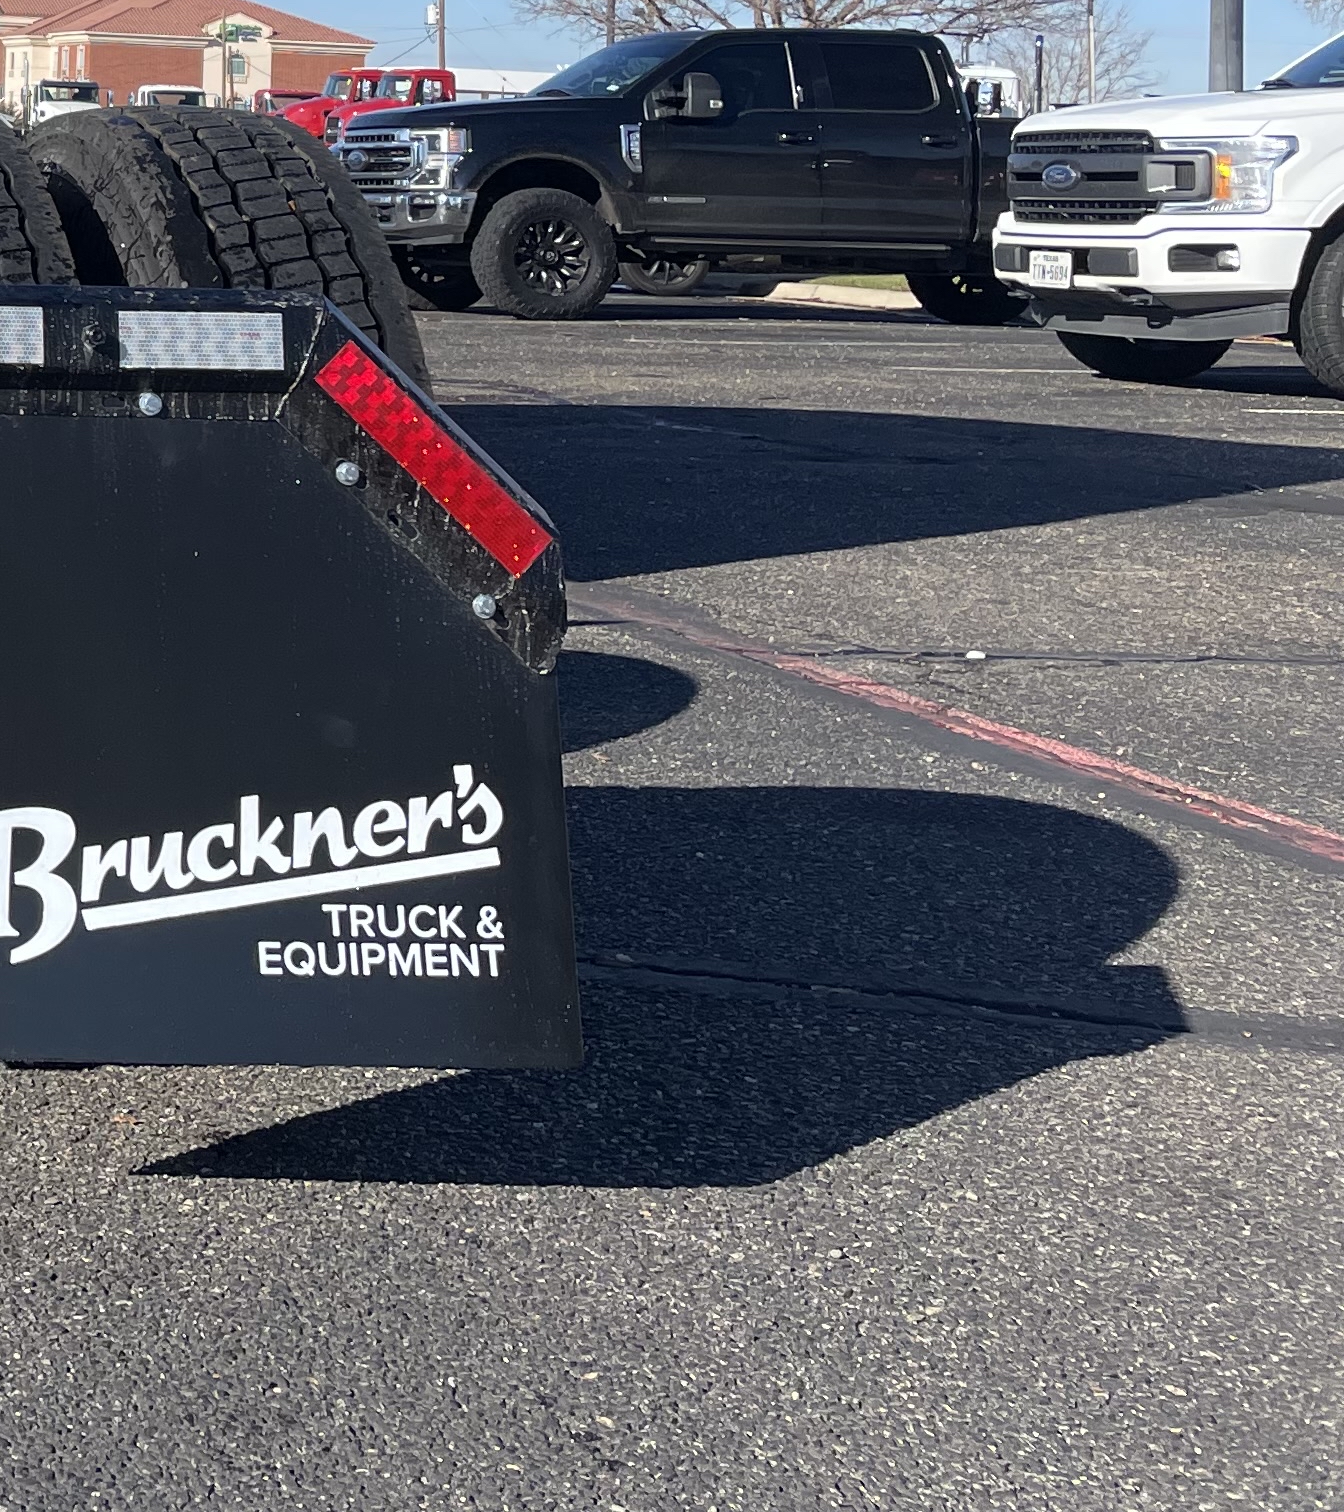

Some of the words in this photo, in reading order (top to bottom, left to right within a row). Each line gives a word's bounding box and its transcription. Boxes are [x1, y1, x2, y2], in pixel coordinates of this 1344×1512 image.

[321, 903, 467, 939] TRUCK
[476, 905, 505, 939] &
[257, 941, 505, 978] EQUIPMENT
